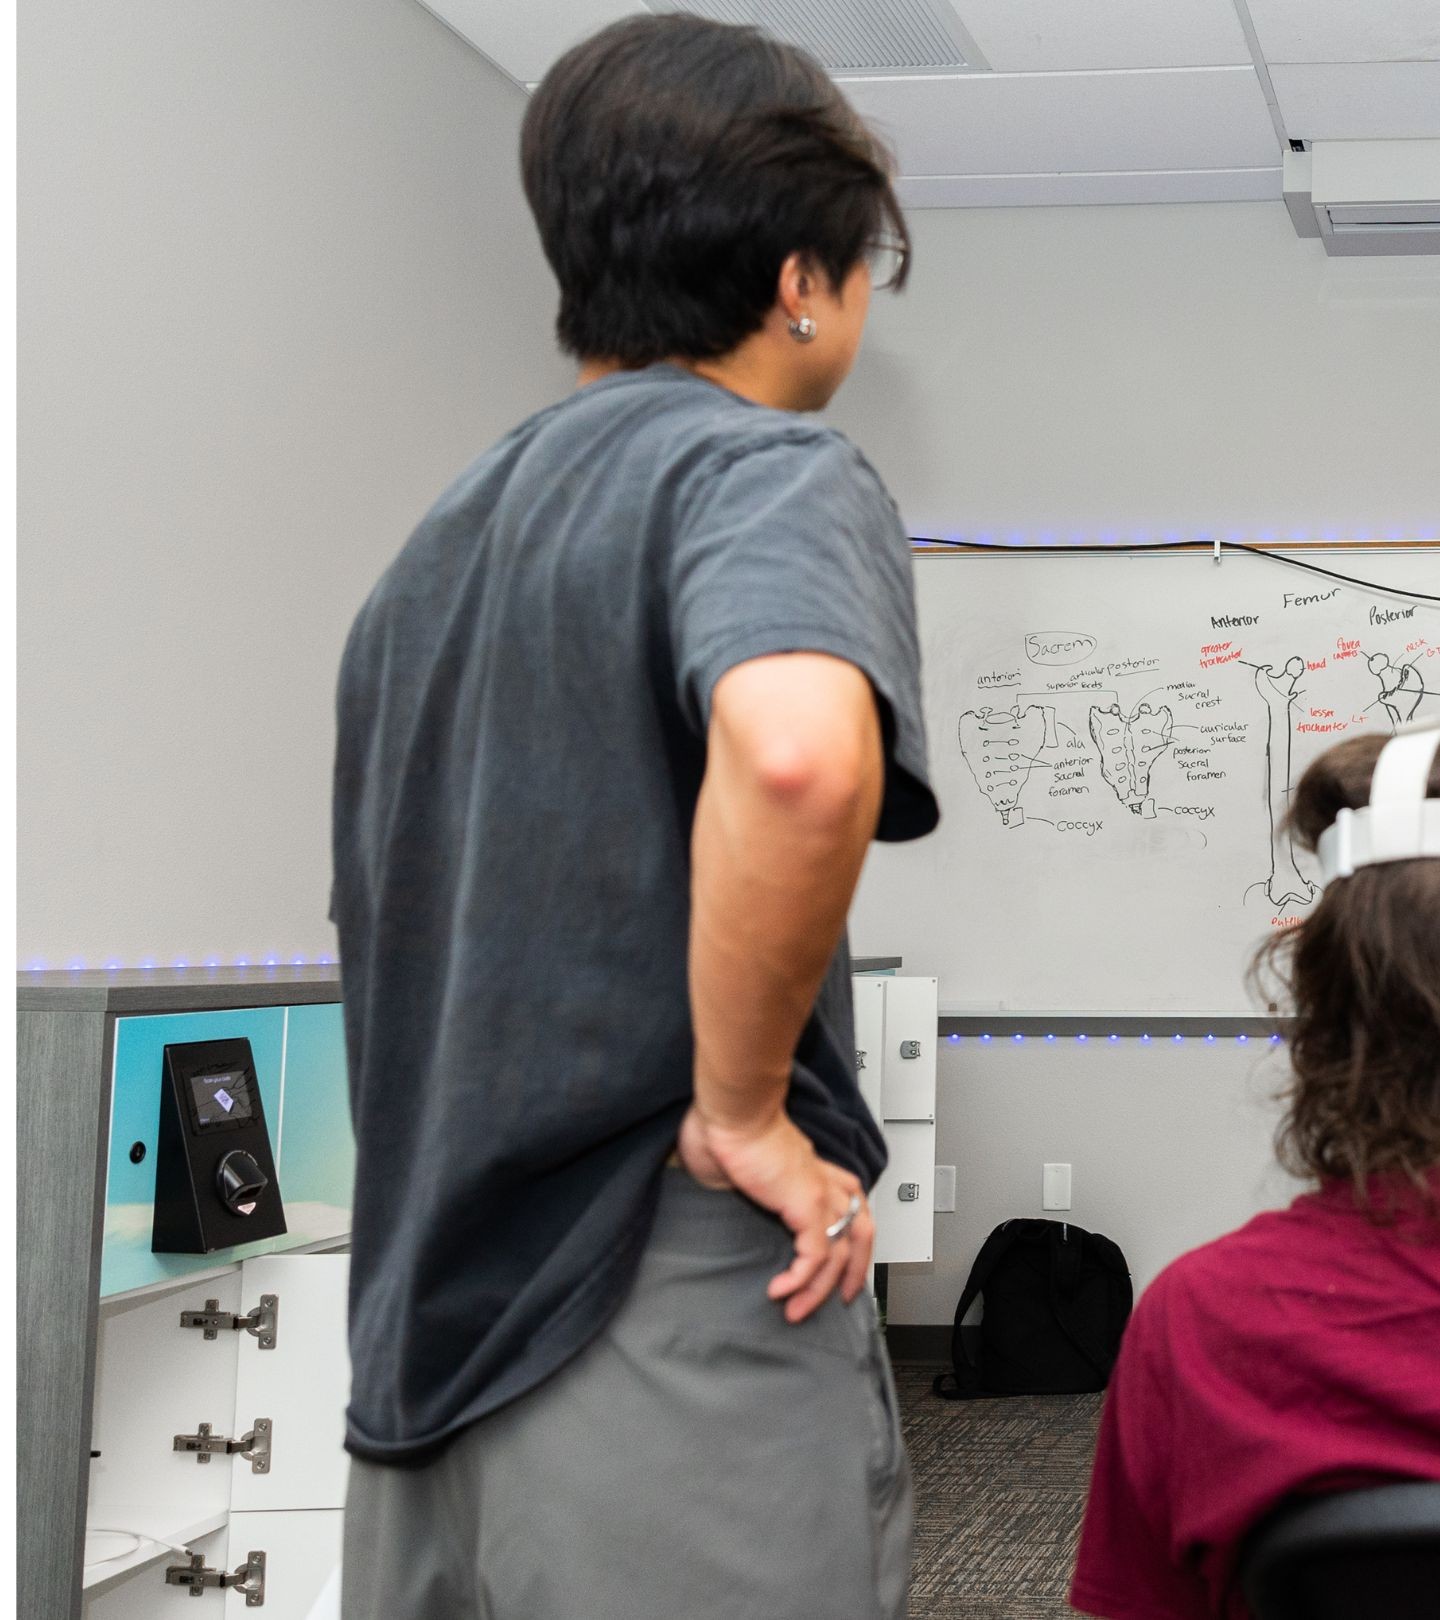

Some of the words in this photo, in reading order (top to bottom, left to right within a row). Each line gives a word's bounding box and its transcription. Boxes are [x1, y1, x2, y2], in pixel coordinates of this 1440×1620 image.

[1283, 587, 1341, 608] Femur
[1369, 605, 1418, 626] Posterior
[1210, 614, 1260, 630] Anterior
[1306, 658, 1327, 670] head
[1066, 737, 1086, 749] ala
[1186, 769, 1227, 781] foramen
[1049, 785, 1090, 797] foramen
